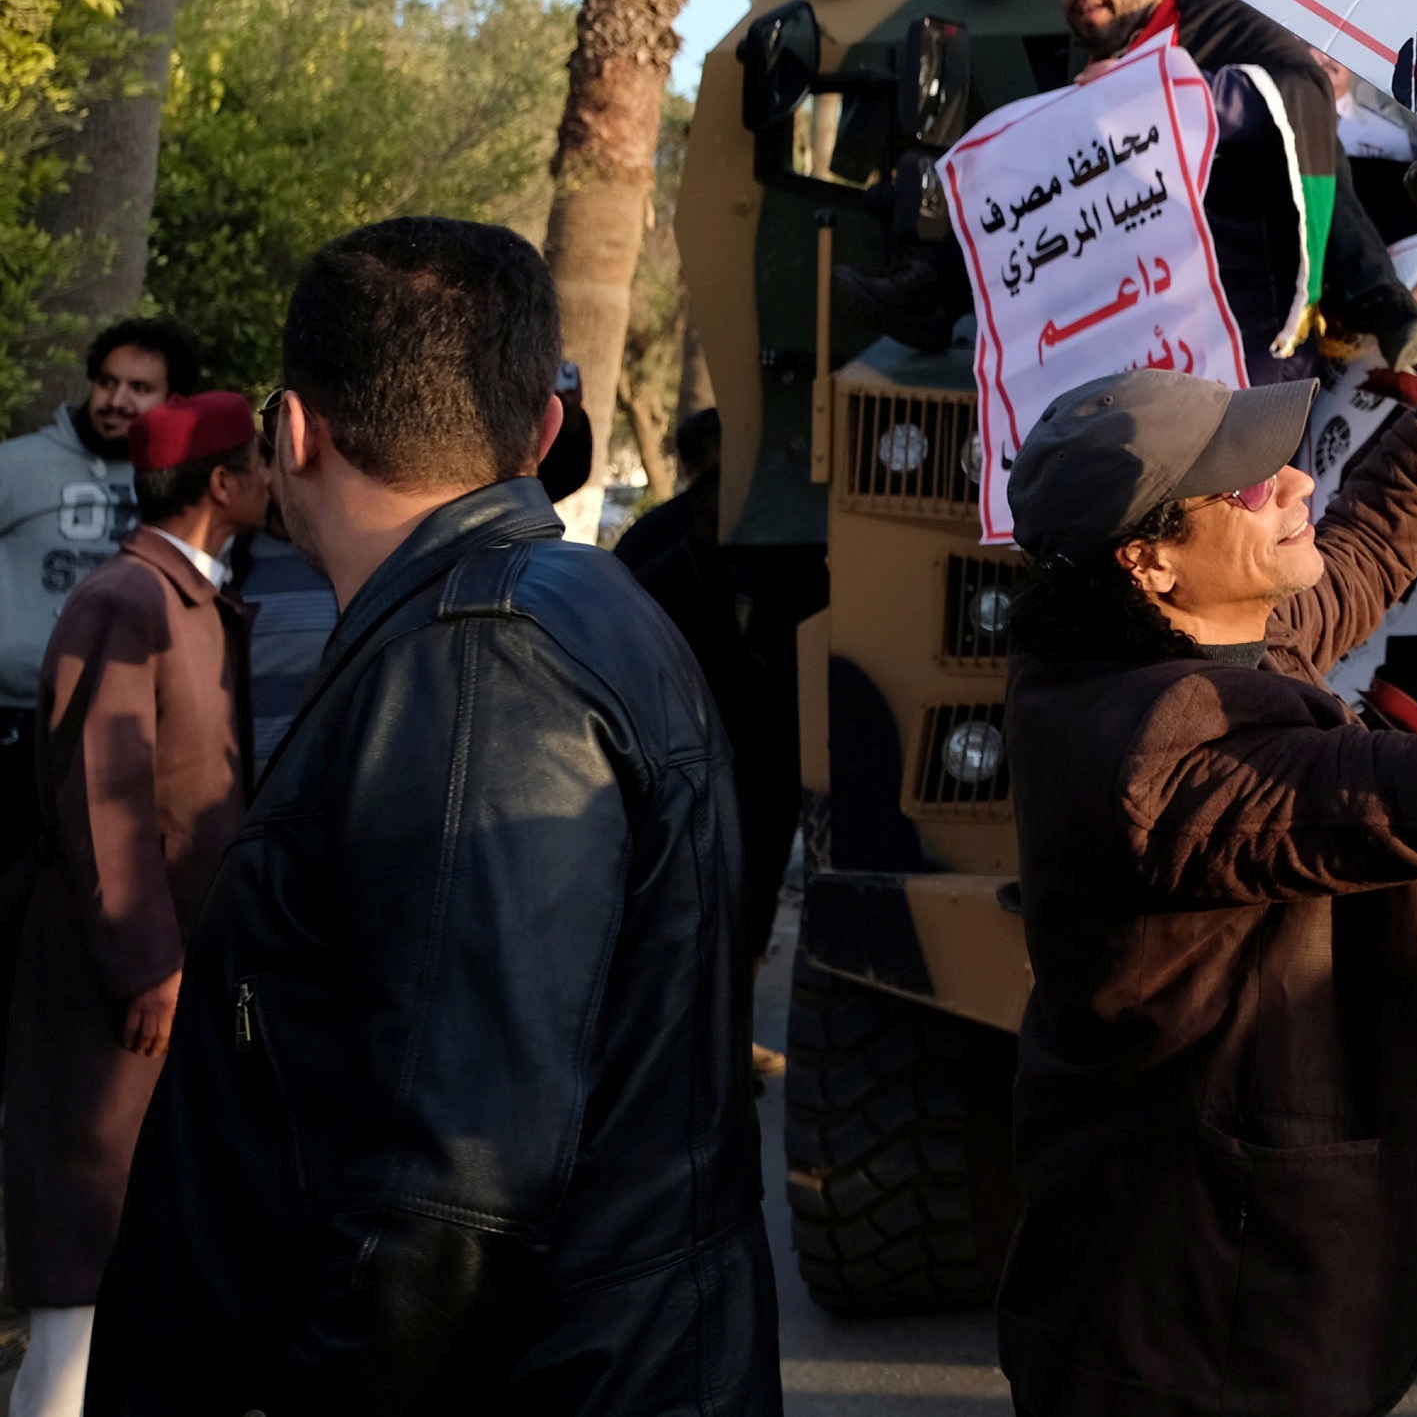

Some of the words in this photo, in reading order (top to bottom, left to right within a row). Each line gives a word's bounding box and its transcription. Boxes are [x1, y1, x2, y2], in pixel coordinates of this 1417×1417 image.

[1068, 125, 1160, 188] محافظ
[980, 175, 1062, 235] مصرف
[1106, 168, 1168, 232] ليبيا
[1001, 200, 1103, 298] المركزي
[1037, 254, 1172, 368] داعم
